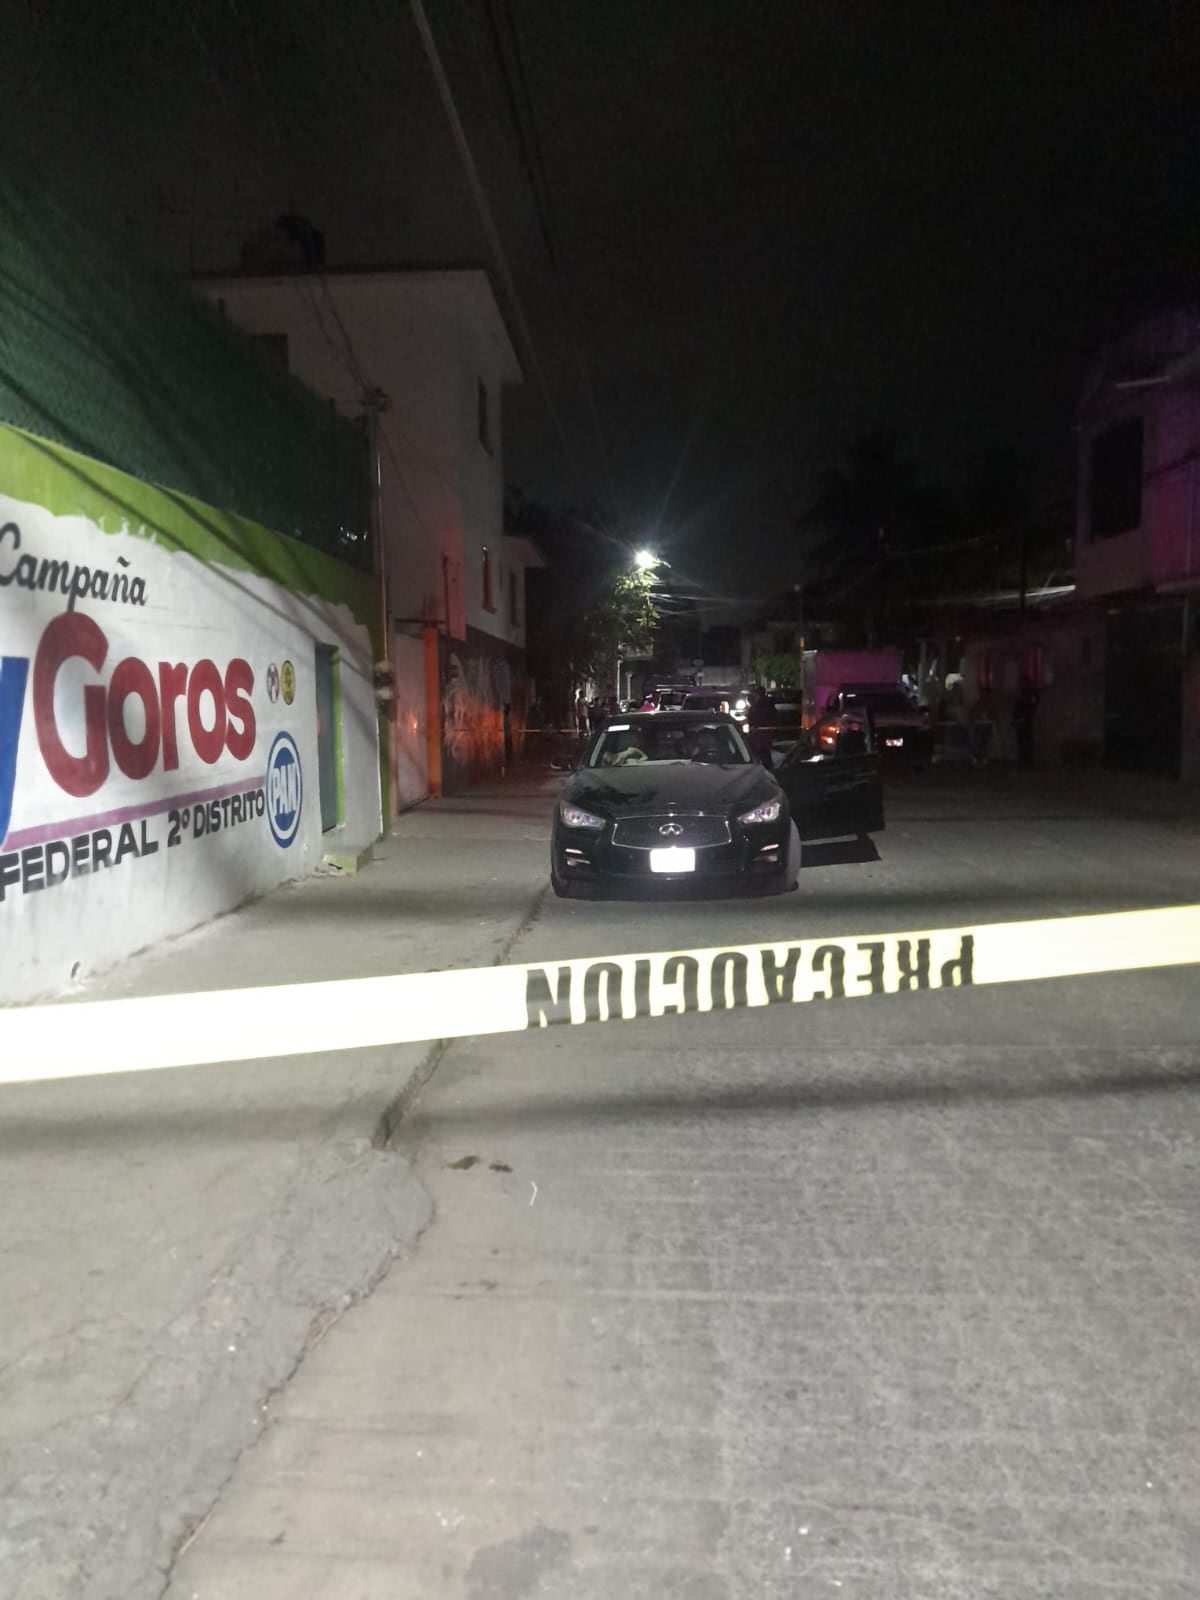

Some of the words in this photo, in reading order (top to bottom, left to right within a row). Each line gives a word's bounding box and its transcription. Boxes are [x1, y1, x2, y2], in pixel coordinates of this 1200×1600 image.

[0, 522, 148, 612] Campaña
[33, 611, 257, 798] Goros
[0, 819, 159, 900] FEDERAL
[193, 788, 265, 839] DISTRITO
